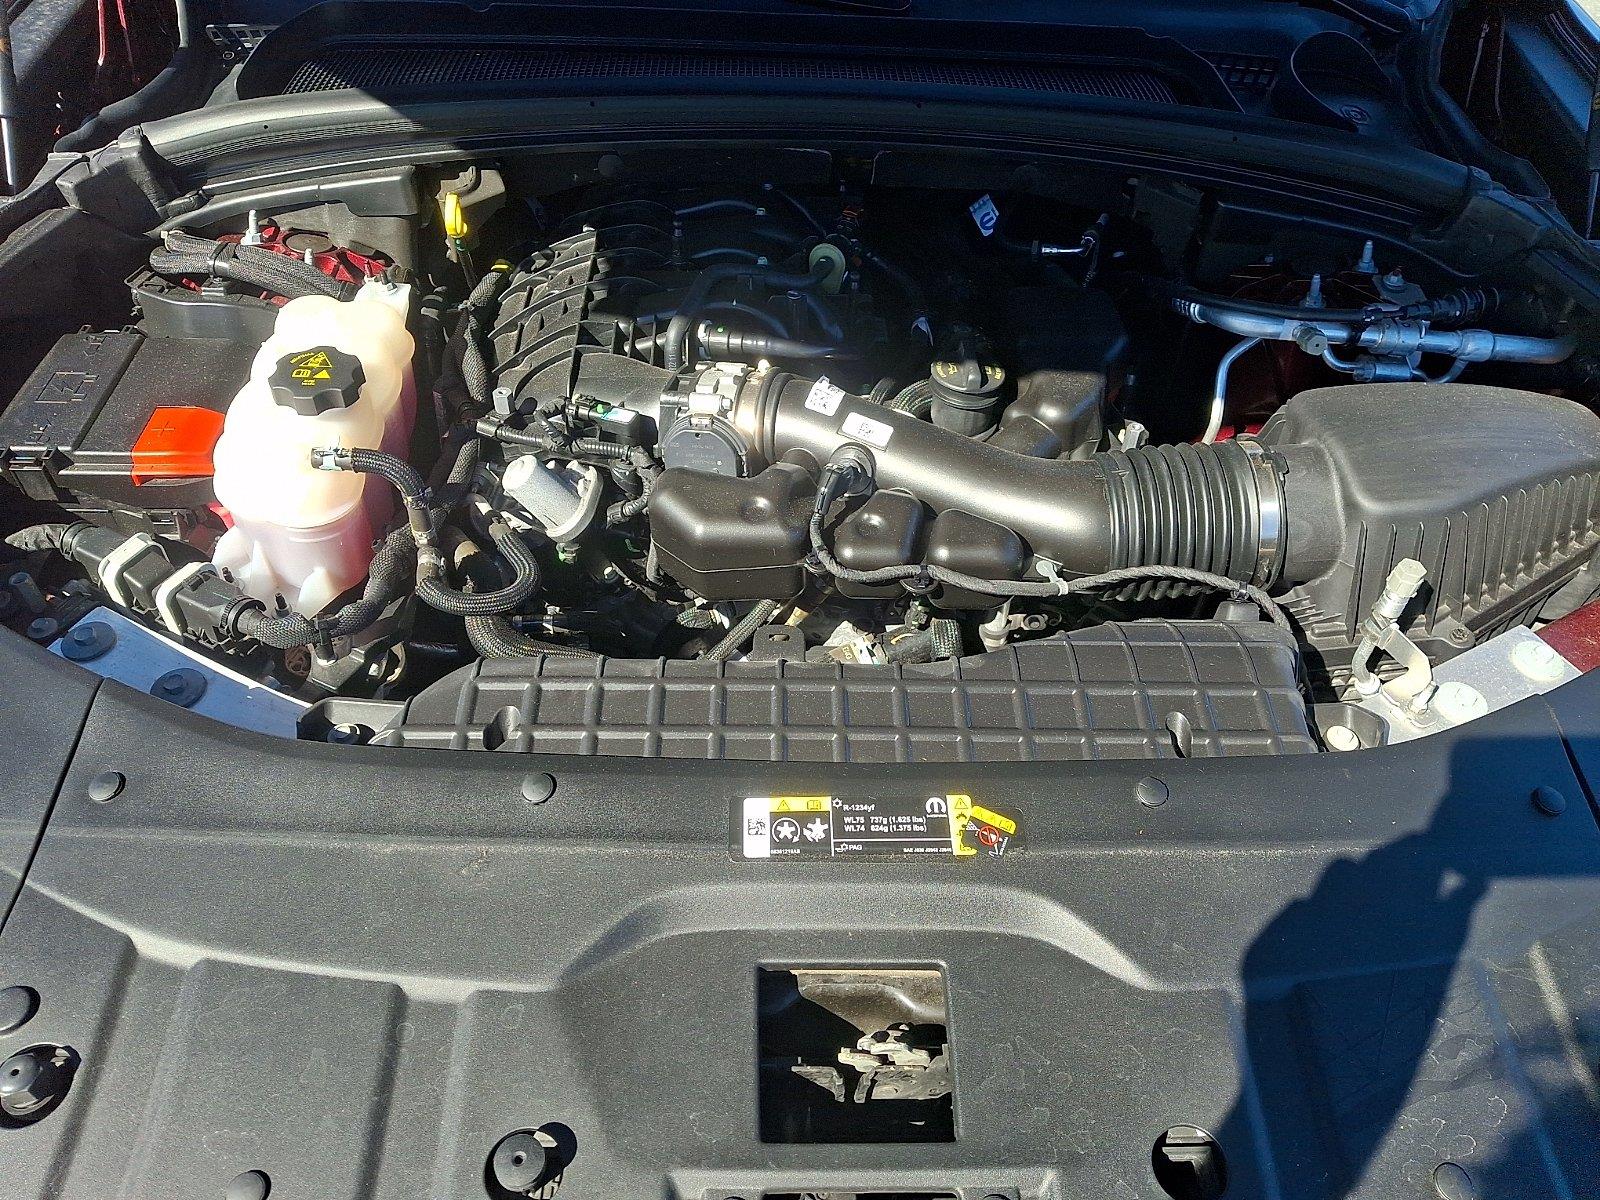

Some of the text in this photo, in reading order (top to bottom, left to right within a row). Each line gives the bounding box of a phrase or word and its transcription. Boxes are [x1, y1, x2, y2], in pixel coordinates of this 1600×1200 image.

[842, 803, 875, 813] R-1234yf
[843, 816, 865, 824] WL75
[912, 816, 927, 824] lbs)
[913, 824, 927, 833] lbs)
